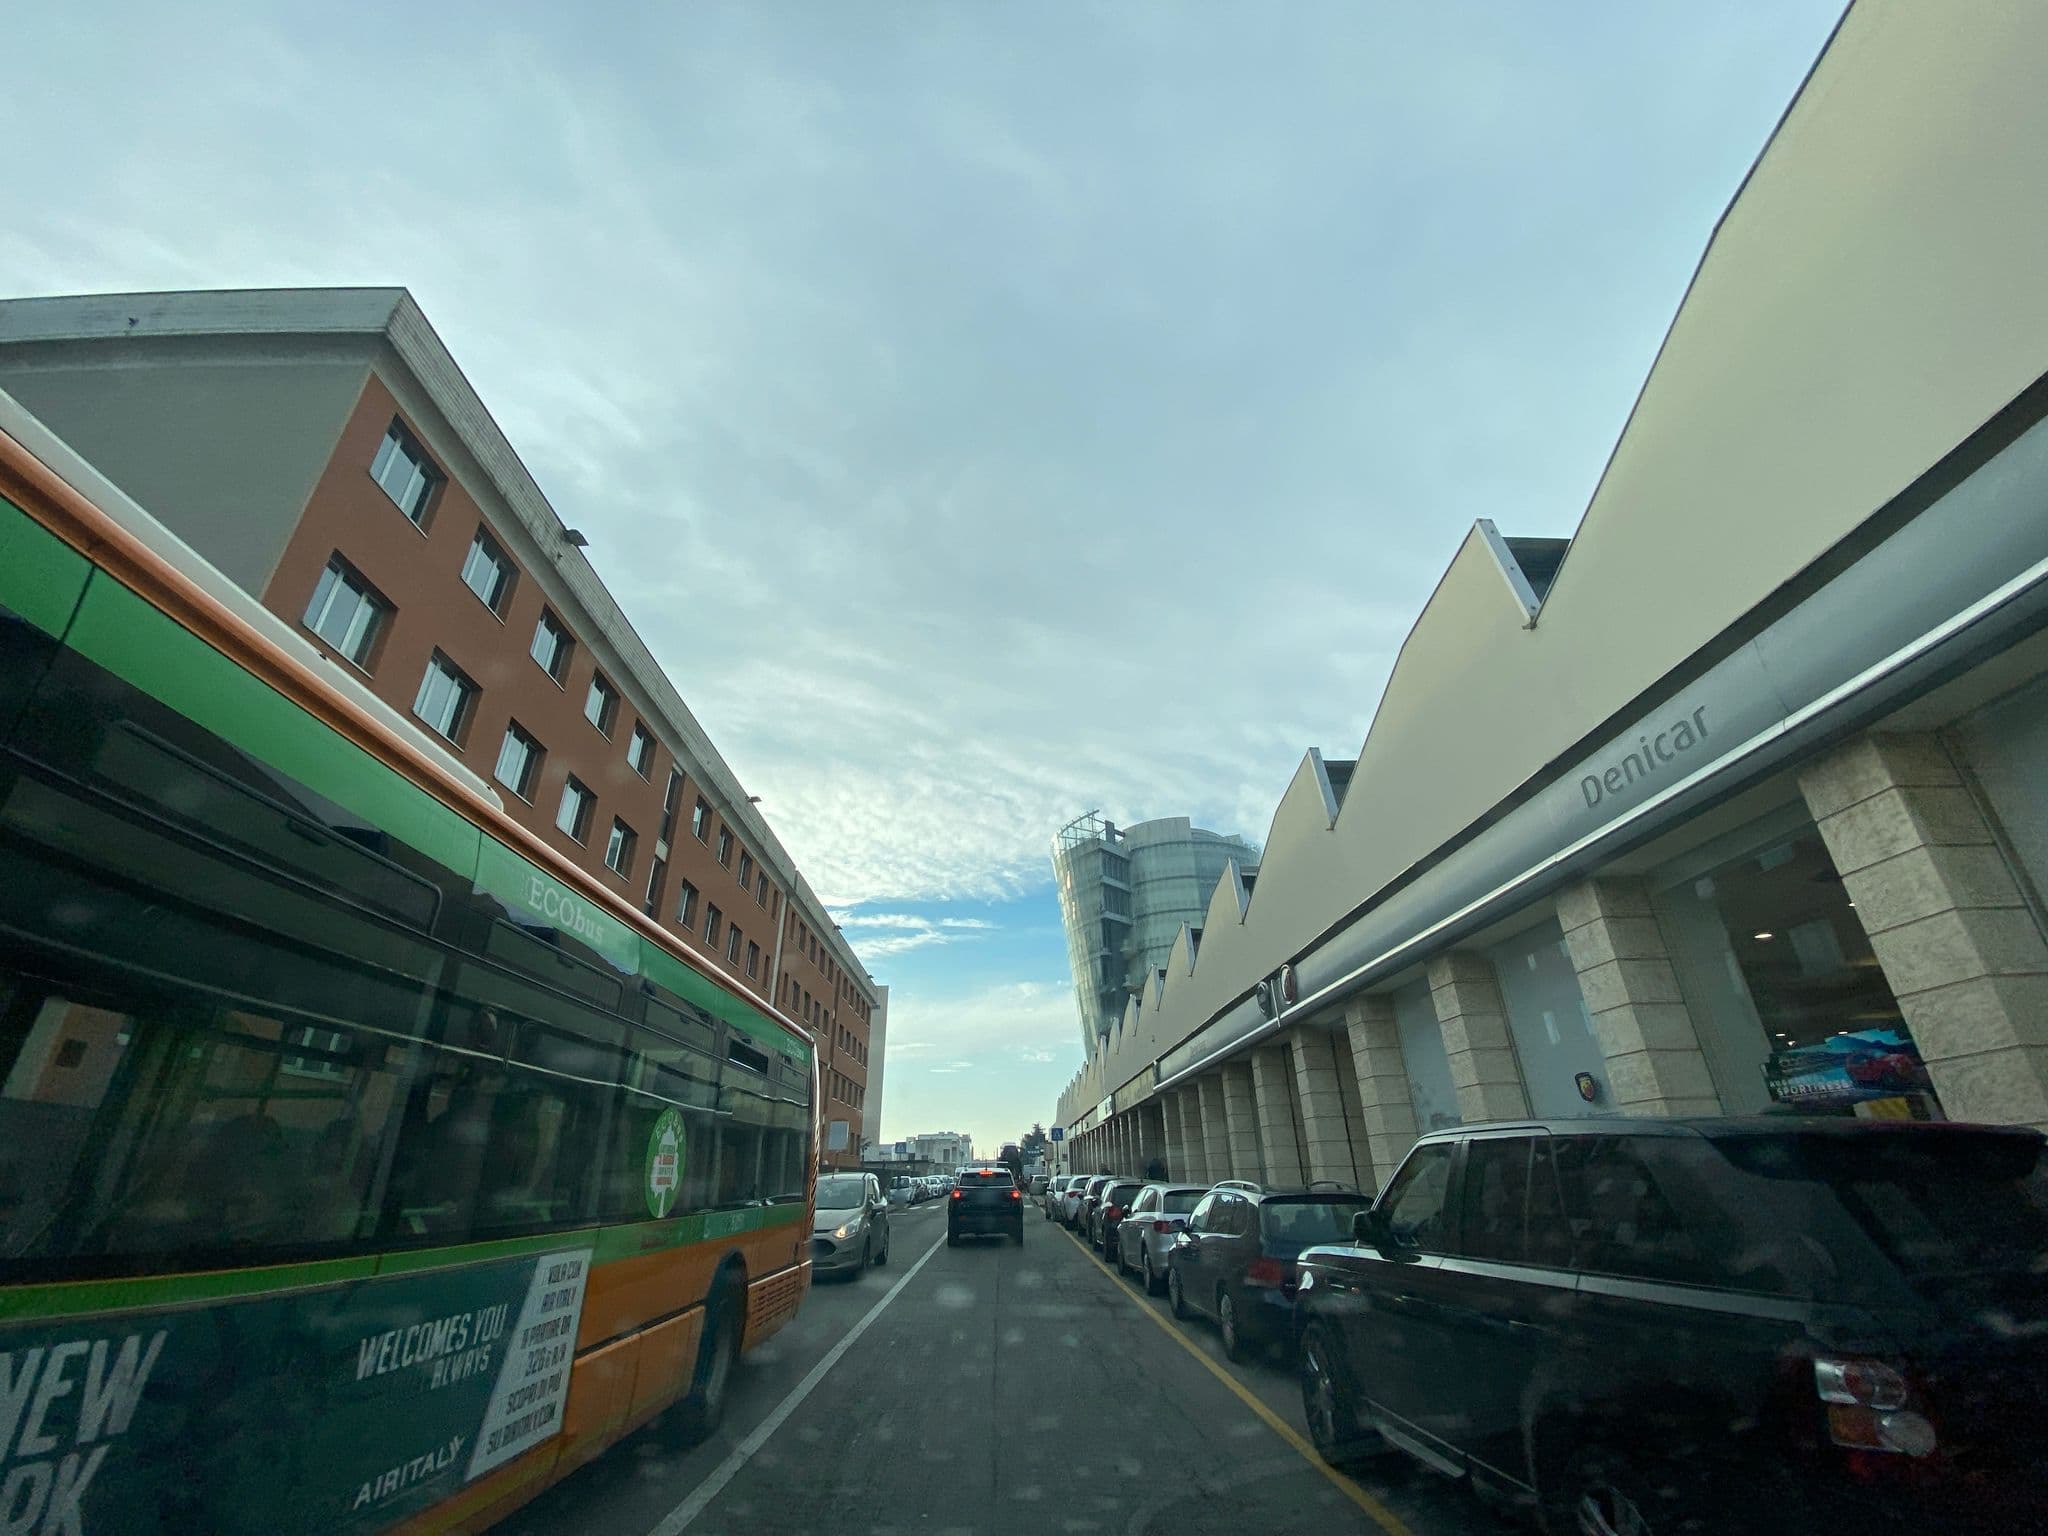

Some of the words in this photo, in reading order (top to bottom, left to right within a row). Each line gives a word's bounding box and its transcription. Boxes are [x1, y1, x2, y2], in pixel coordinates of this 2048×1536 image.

[1580, 705, 1709, 809] Denicar
[528, 875, 604, 944] ECObus
[356, 1312, 472, 1381] WELCOMES
[473, 1303, 509, 1345] YOU
[430, 1343, 492, 1390] ALWAYS
